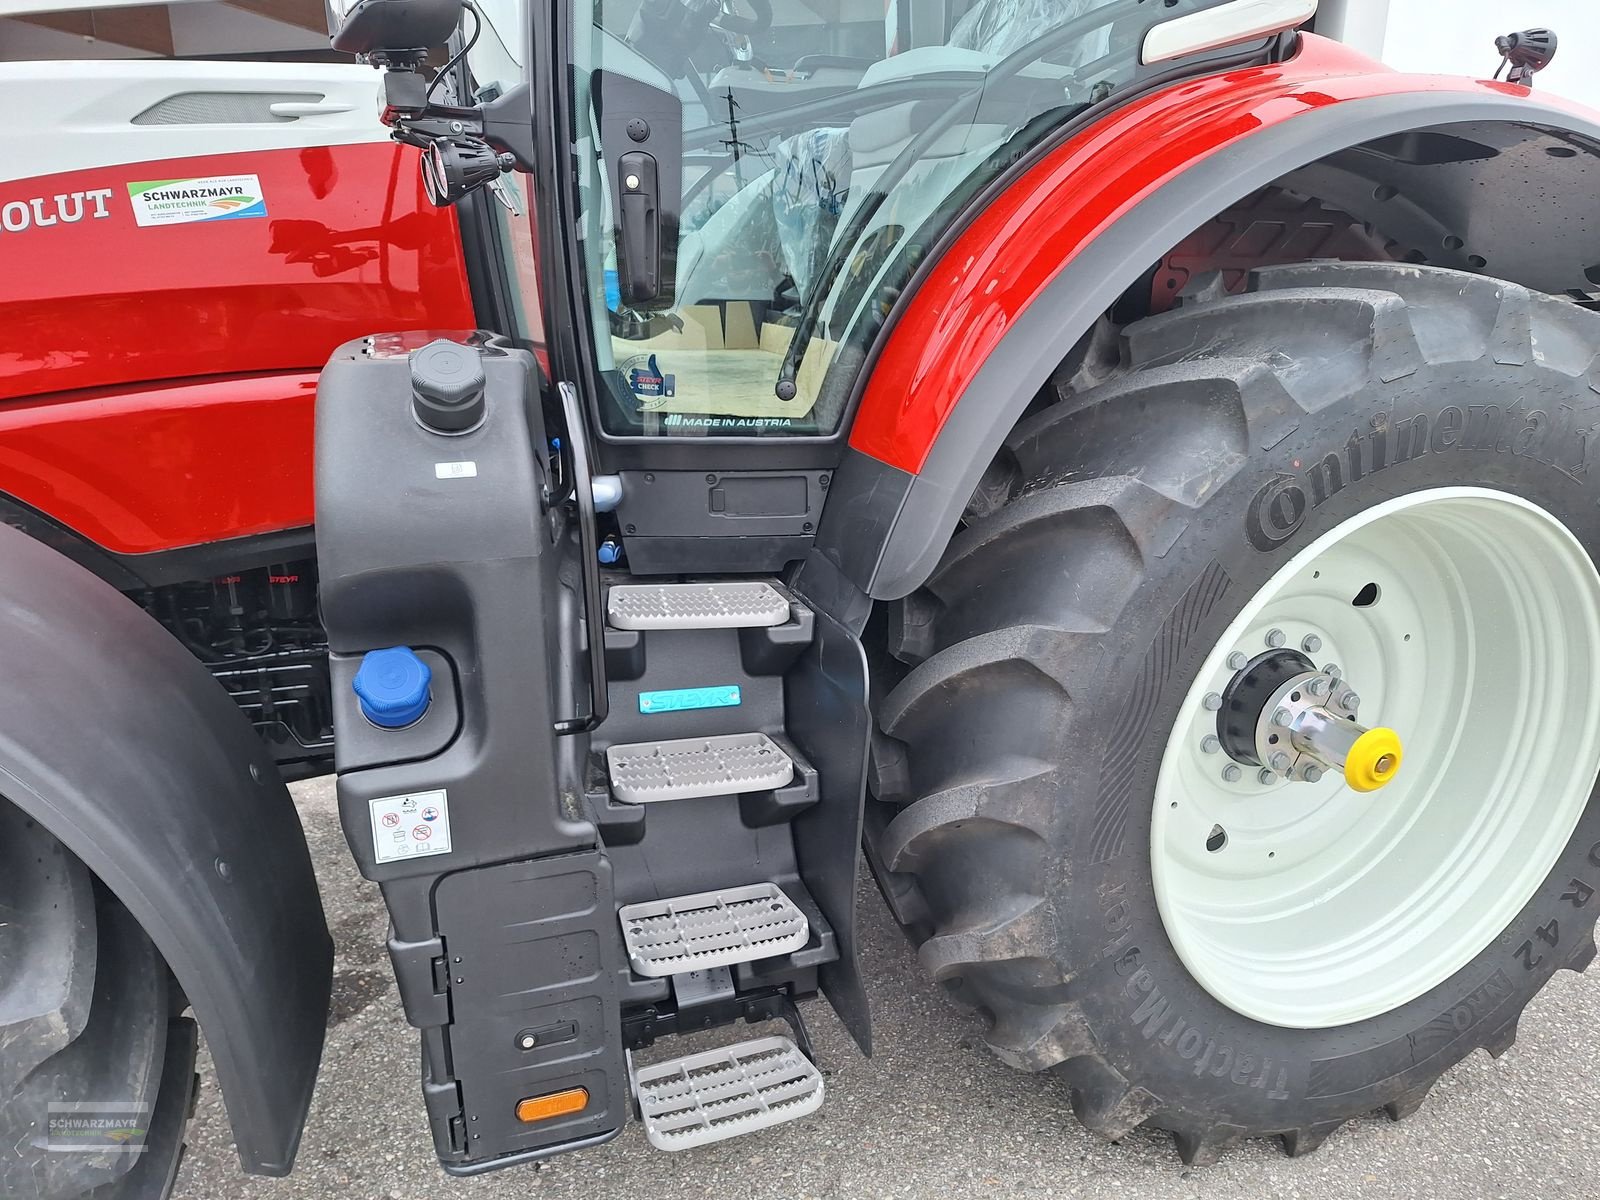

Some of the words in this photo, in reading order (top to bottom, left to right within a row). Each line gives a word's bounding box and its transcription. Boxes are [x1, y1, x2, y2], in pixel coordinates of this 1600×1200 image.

[143, 186, 243, 202] SCHWARZMAYR
[148, 200, 207, 211] LANDTECHNIK
[0, 188, 112, 232] OLUT
[683, 418, 720, 427] MADE
[722, 418, 735, 427] IN
[737, 418, 791, 427] AUSTRIA
[1245, 396, 1576, 552] Continental
[269, 575, 298, 584] STEYR
[649, 687, 731, 710] STEYR
[1560, 878, 1596, 908] R
[1512, 918, 1560, 971] 42
[1096, 881, 1290, 1101] TractorMaster
